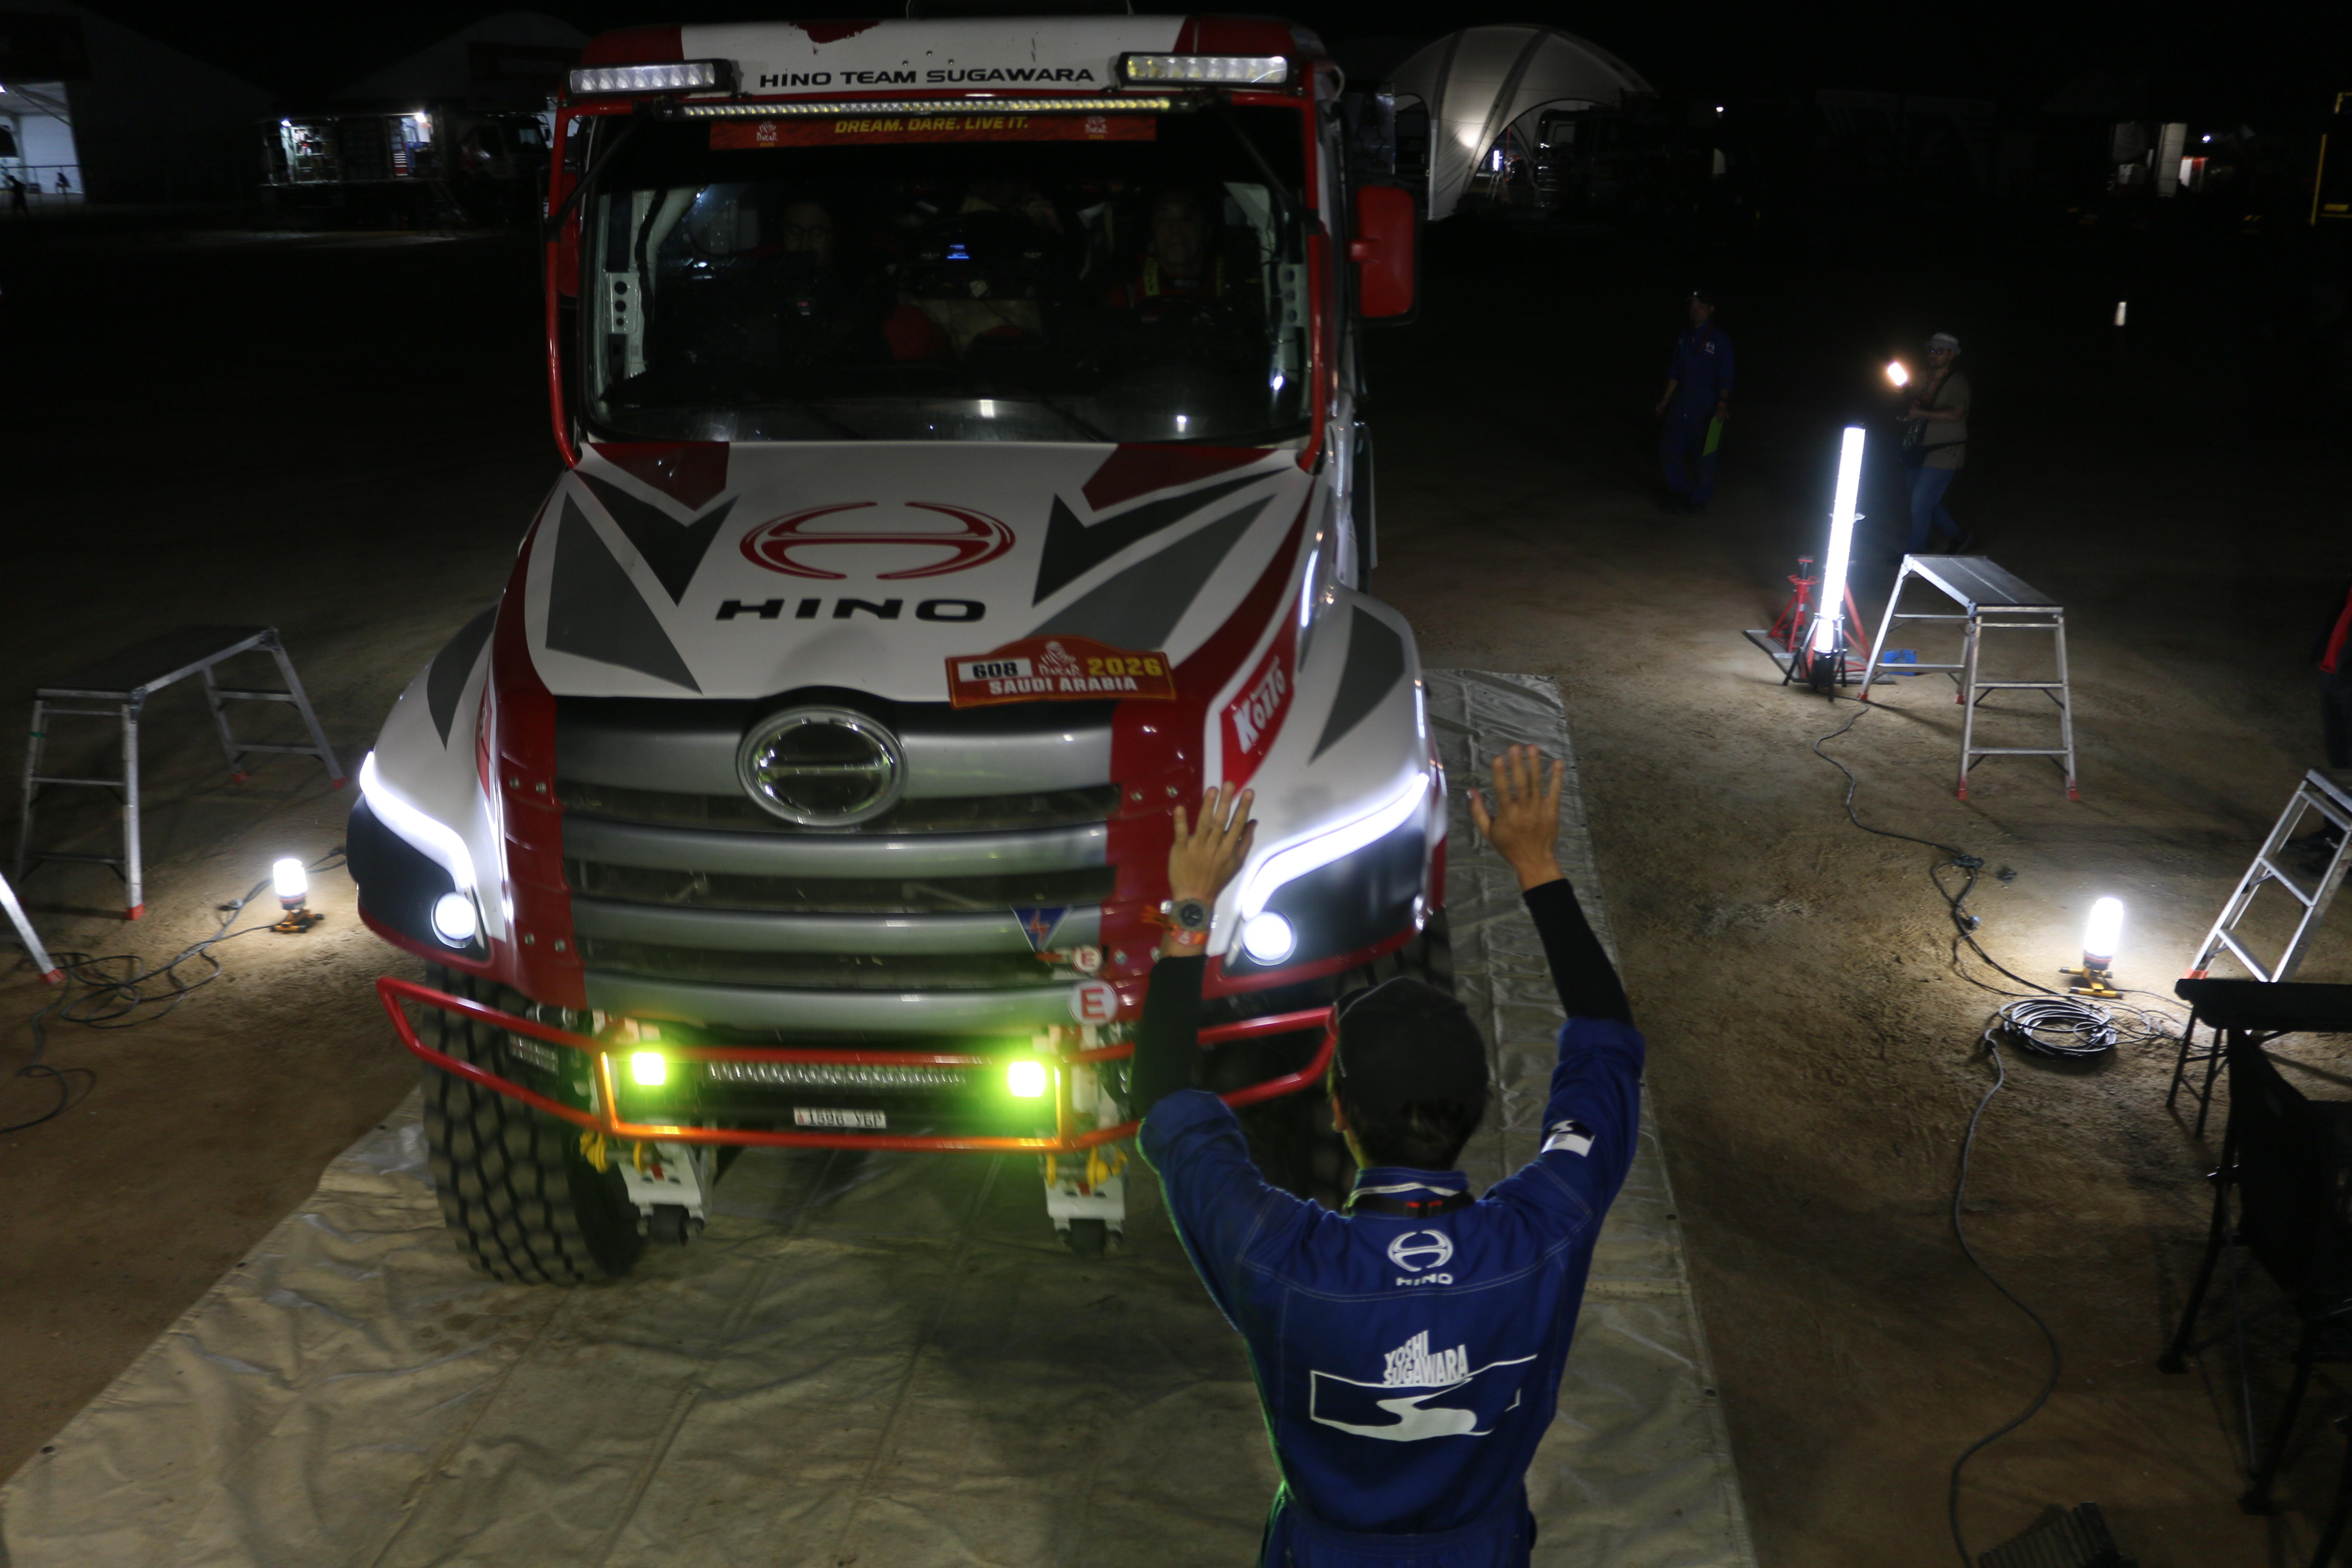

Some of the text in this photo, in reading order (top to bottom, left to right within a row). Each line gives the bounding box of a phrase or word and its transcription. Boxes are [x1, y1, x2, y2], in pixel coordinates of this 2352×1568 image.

[760, 68, 1095, 88] HINO TEAM SUGAWARA
[834, 115, 1029, 134] DREAM. DARE. LIVE IT.
[715, 598, 987, 623] HINO
[972, 661, 1018, 680] 608
[1087, 657, 1163, 677] 2026
[989, 677, 1139, 695] SAUDI ARABIA
[1081, 952, 1096, 967] E
[1081, 987, 1107, 1020] E
[1396, 1273, 1453, 1286] HINO
[1384, 1329, 1429, 1370] YOSHI
[1383, 1344, 1469, 1385] SUGAWARA
